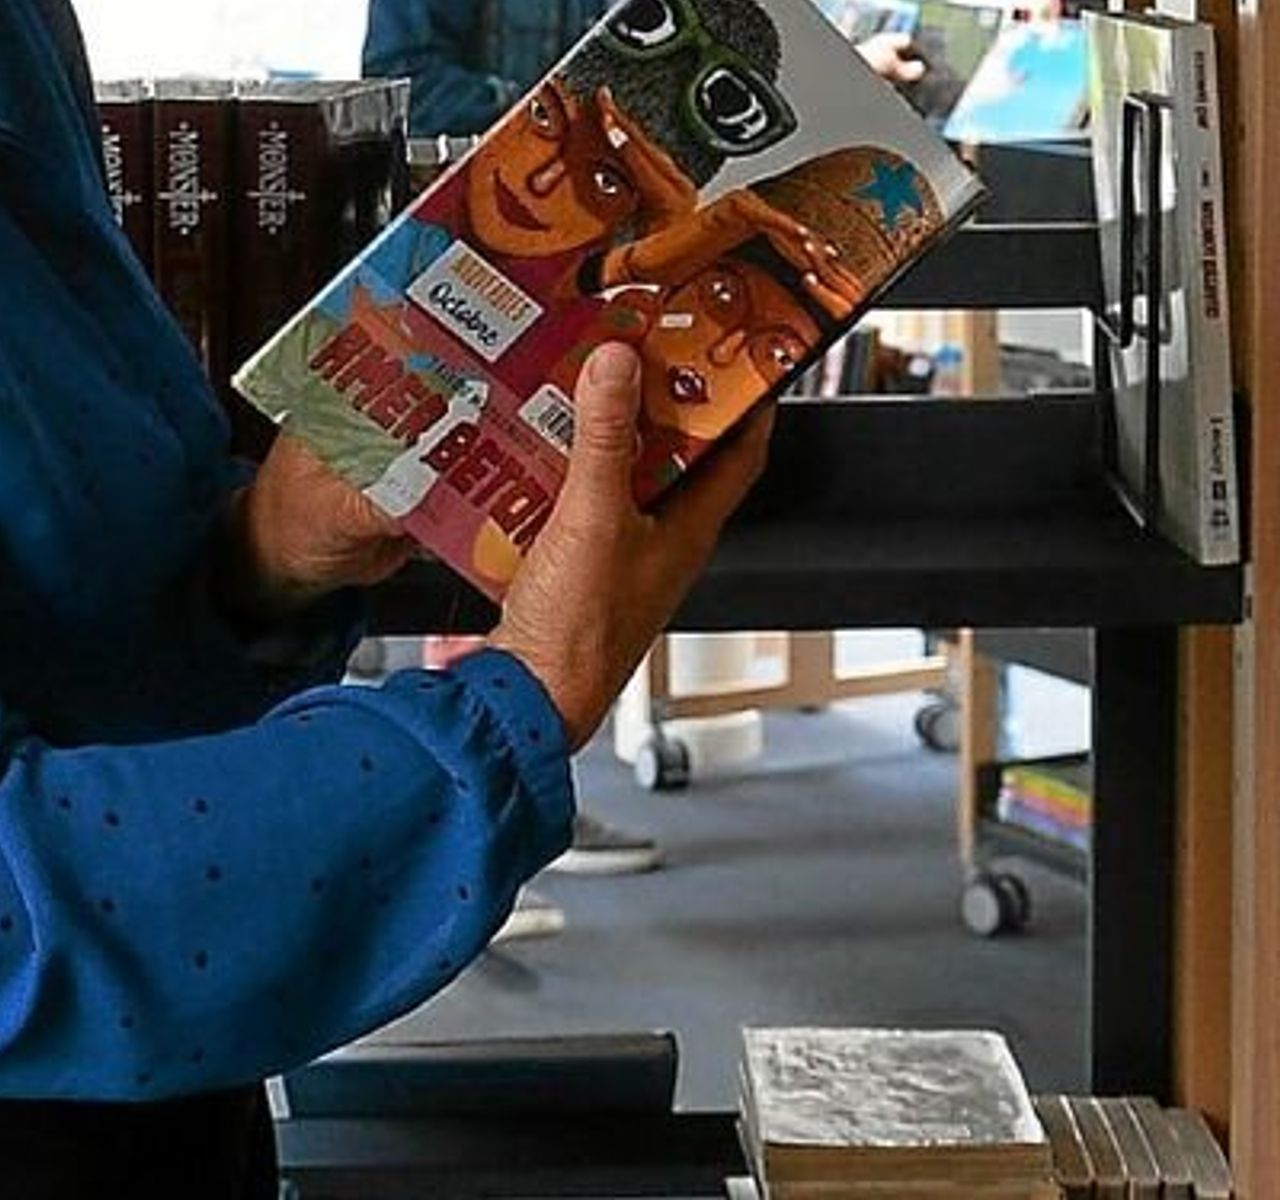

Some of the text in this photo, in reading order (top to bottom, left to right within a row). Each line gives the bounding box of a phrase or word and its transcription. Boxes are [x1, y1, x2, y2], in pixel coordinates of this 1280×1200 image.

[163, 129, 210, 227] MONSTER
[250, 129, 297, 227] MONSTER
[429, 281, 498, 346] Octobre
